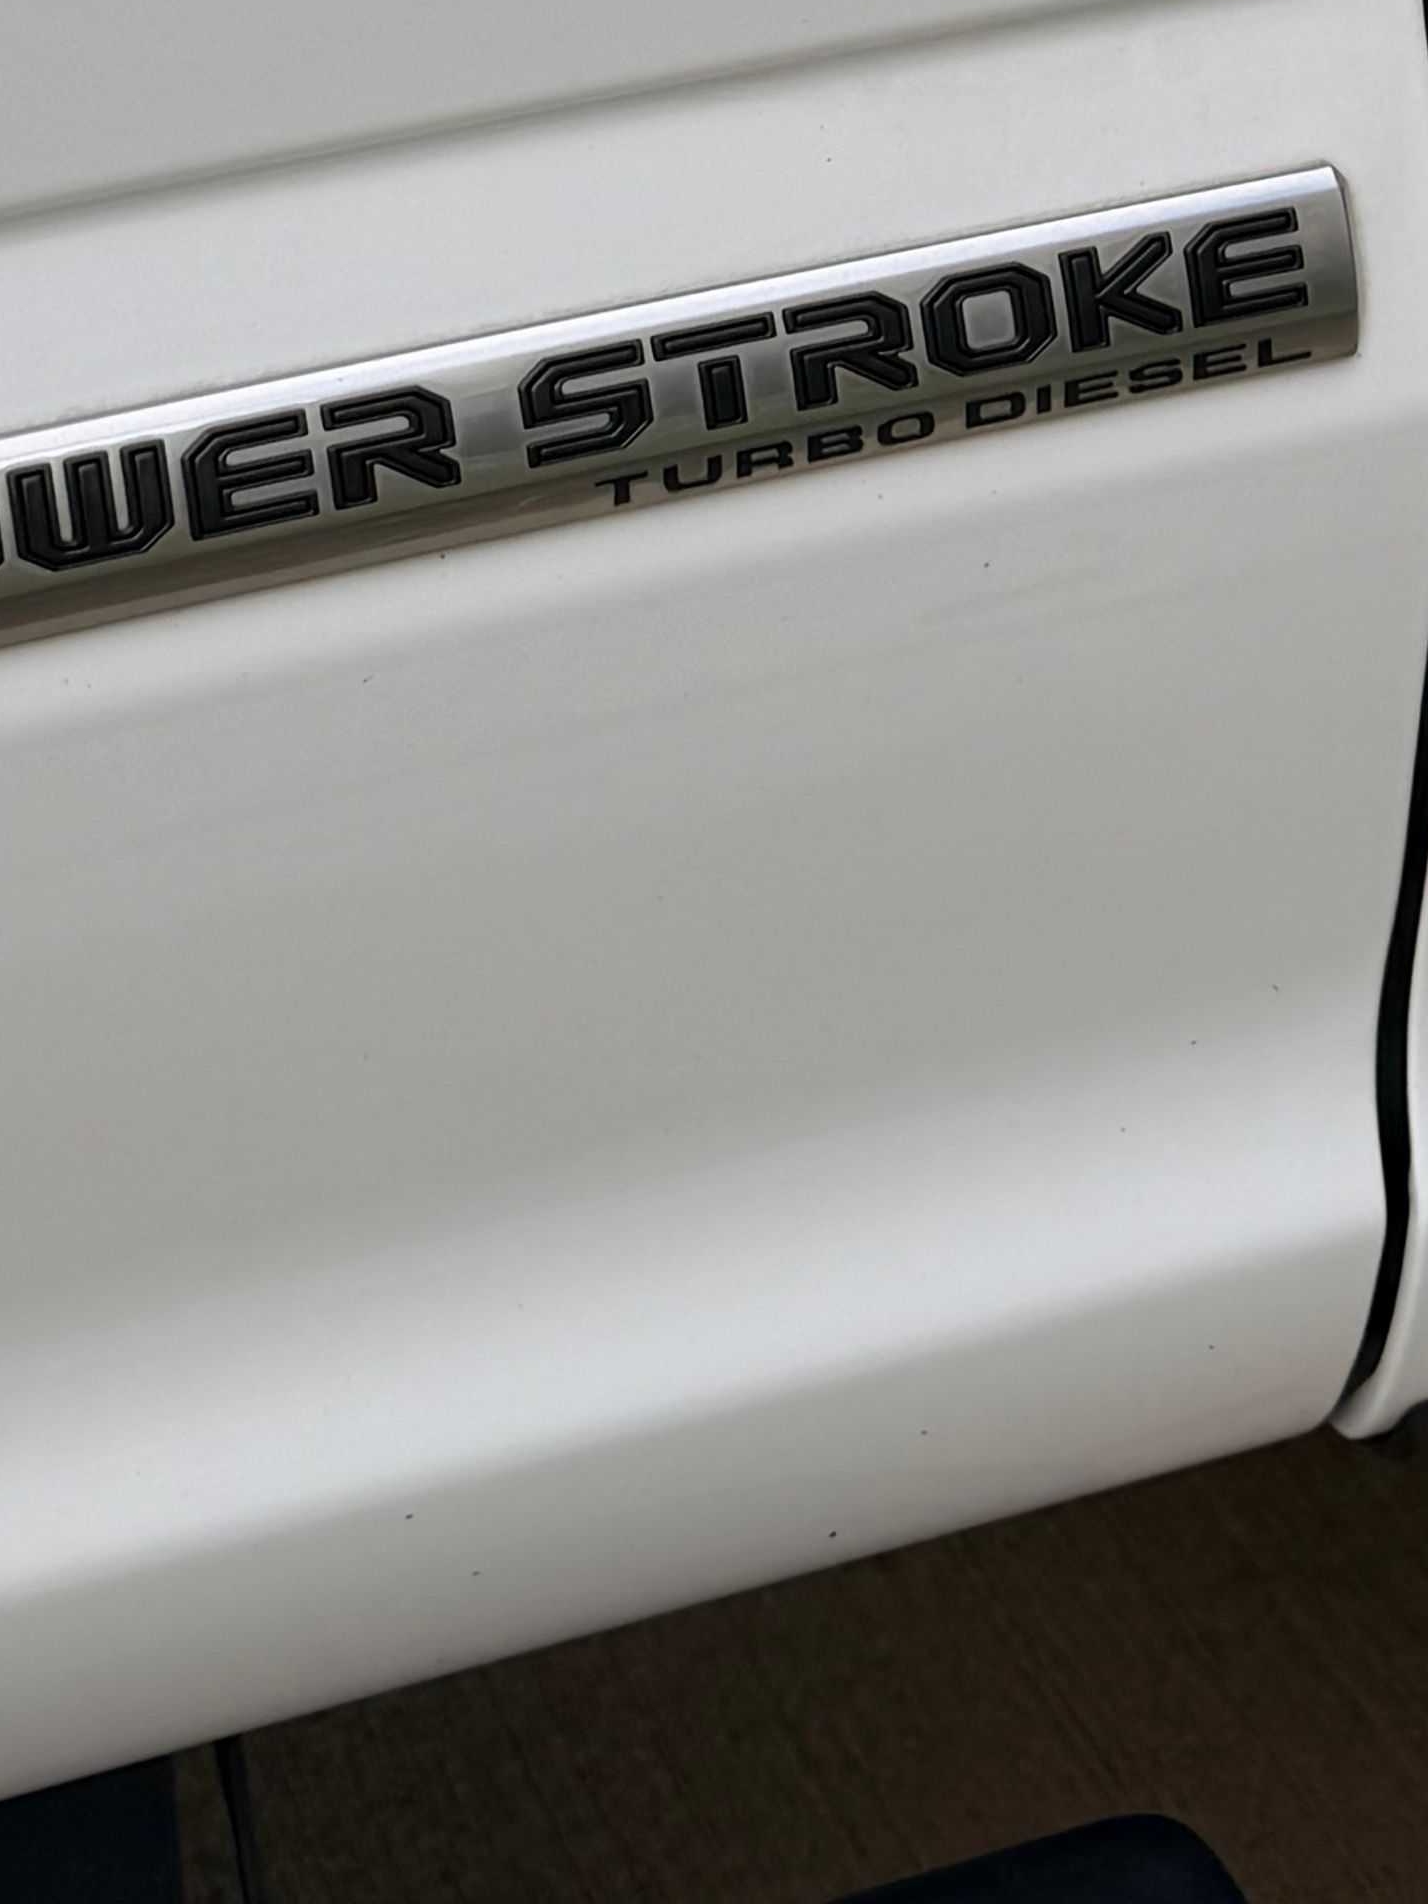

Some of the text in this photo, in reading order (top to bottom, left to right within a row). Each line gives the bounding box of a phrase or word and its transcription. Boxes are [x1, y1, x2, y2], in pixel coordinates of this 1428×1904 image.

[517, 205, 1310, 469] STROKE
[594, 337, 1312, 507] TURBO DIESEL
